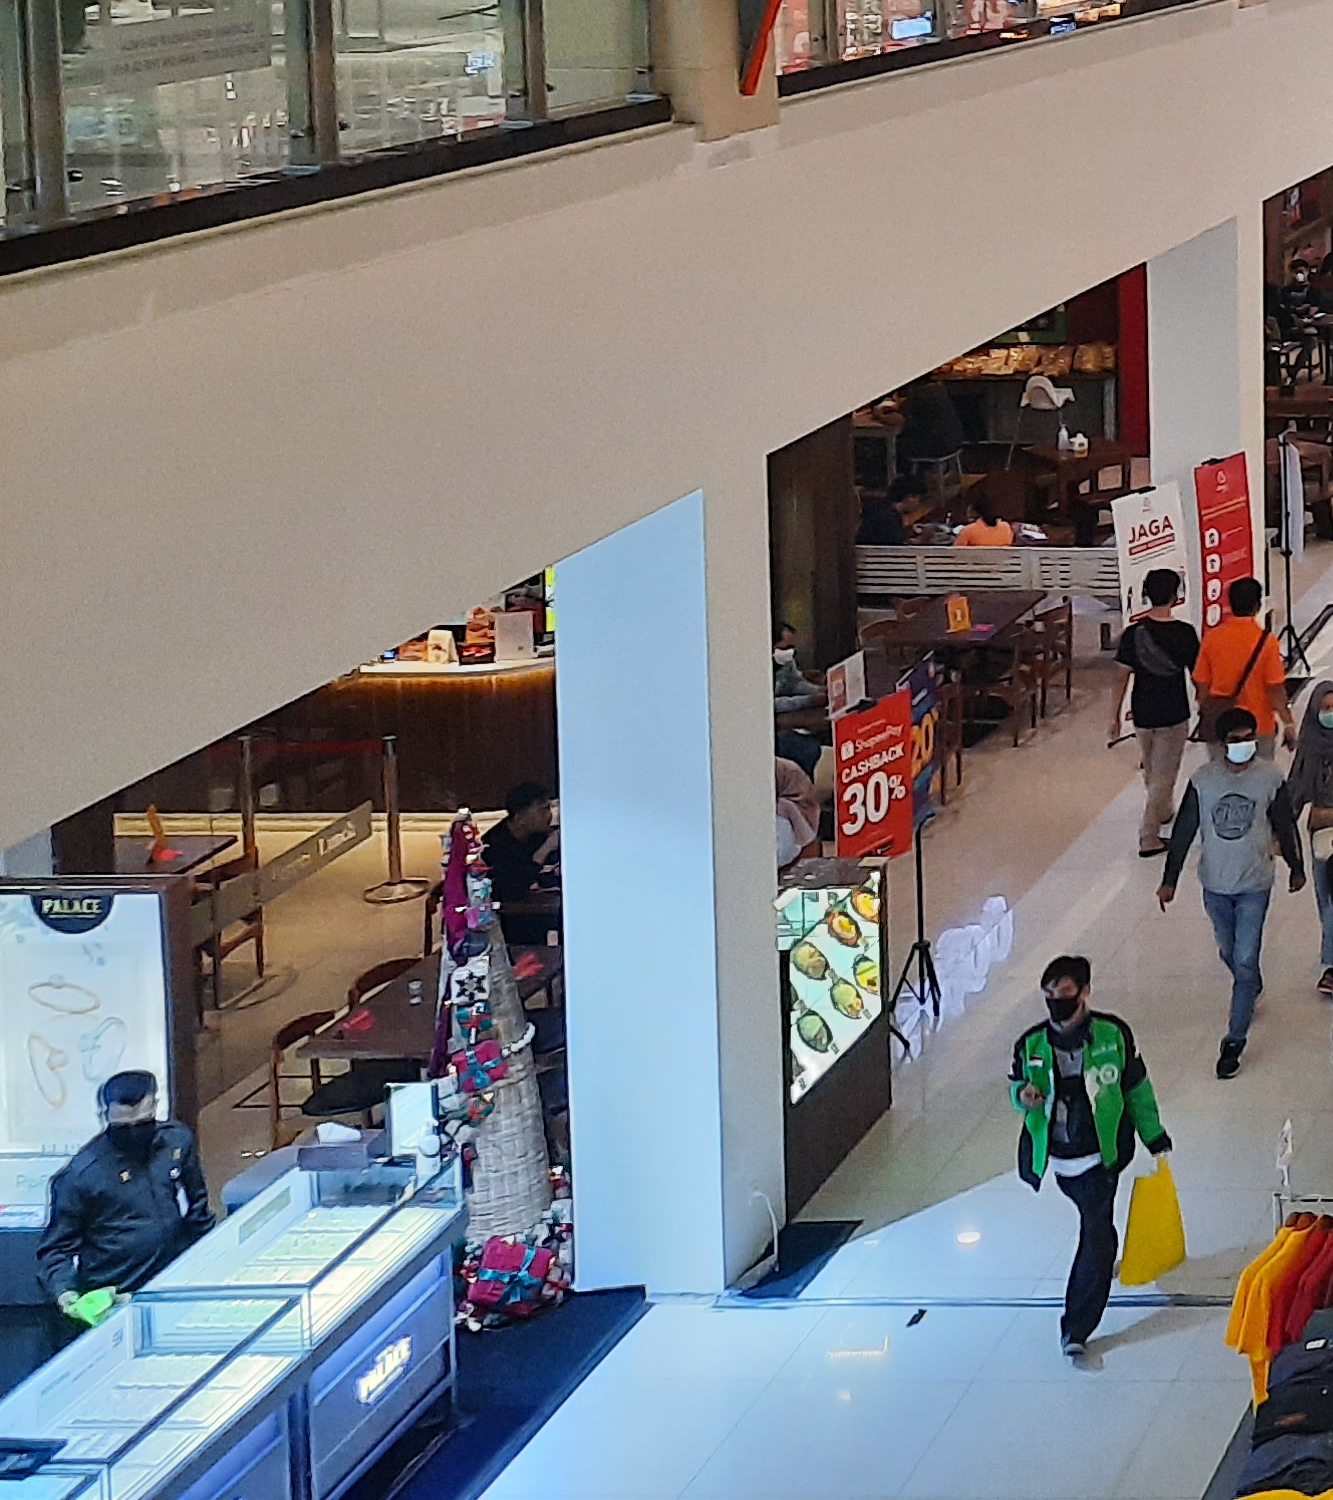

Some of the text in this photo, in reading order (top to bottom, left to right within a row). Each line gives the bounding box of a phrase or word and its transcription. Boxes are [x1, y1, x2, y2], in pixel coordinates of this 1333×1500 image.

[1128, 515, 1174, 545] JAGA
[842, 741, 906, 784] CASHBACK
[842, 771, 906, 836] 30%
[41, 898, 103, 914] PALACE
